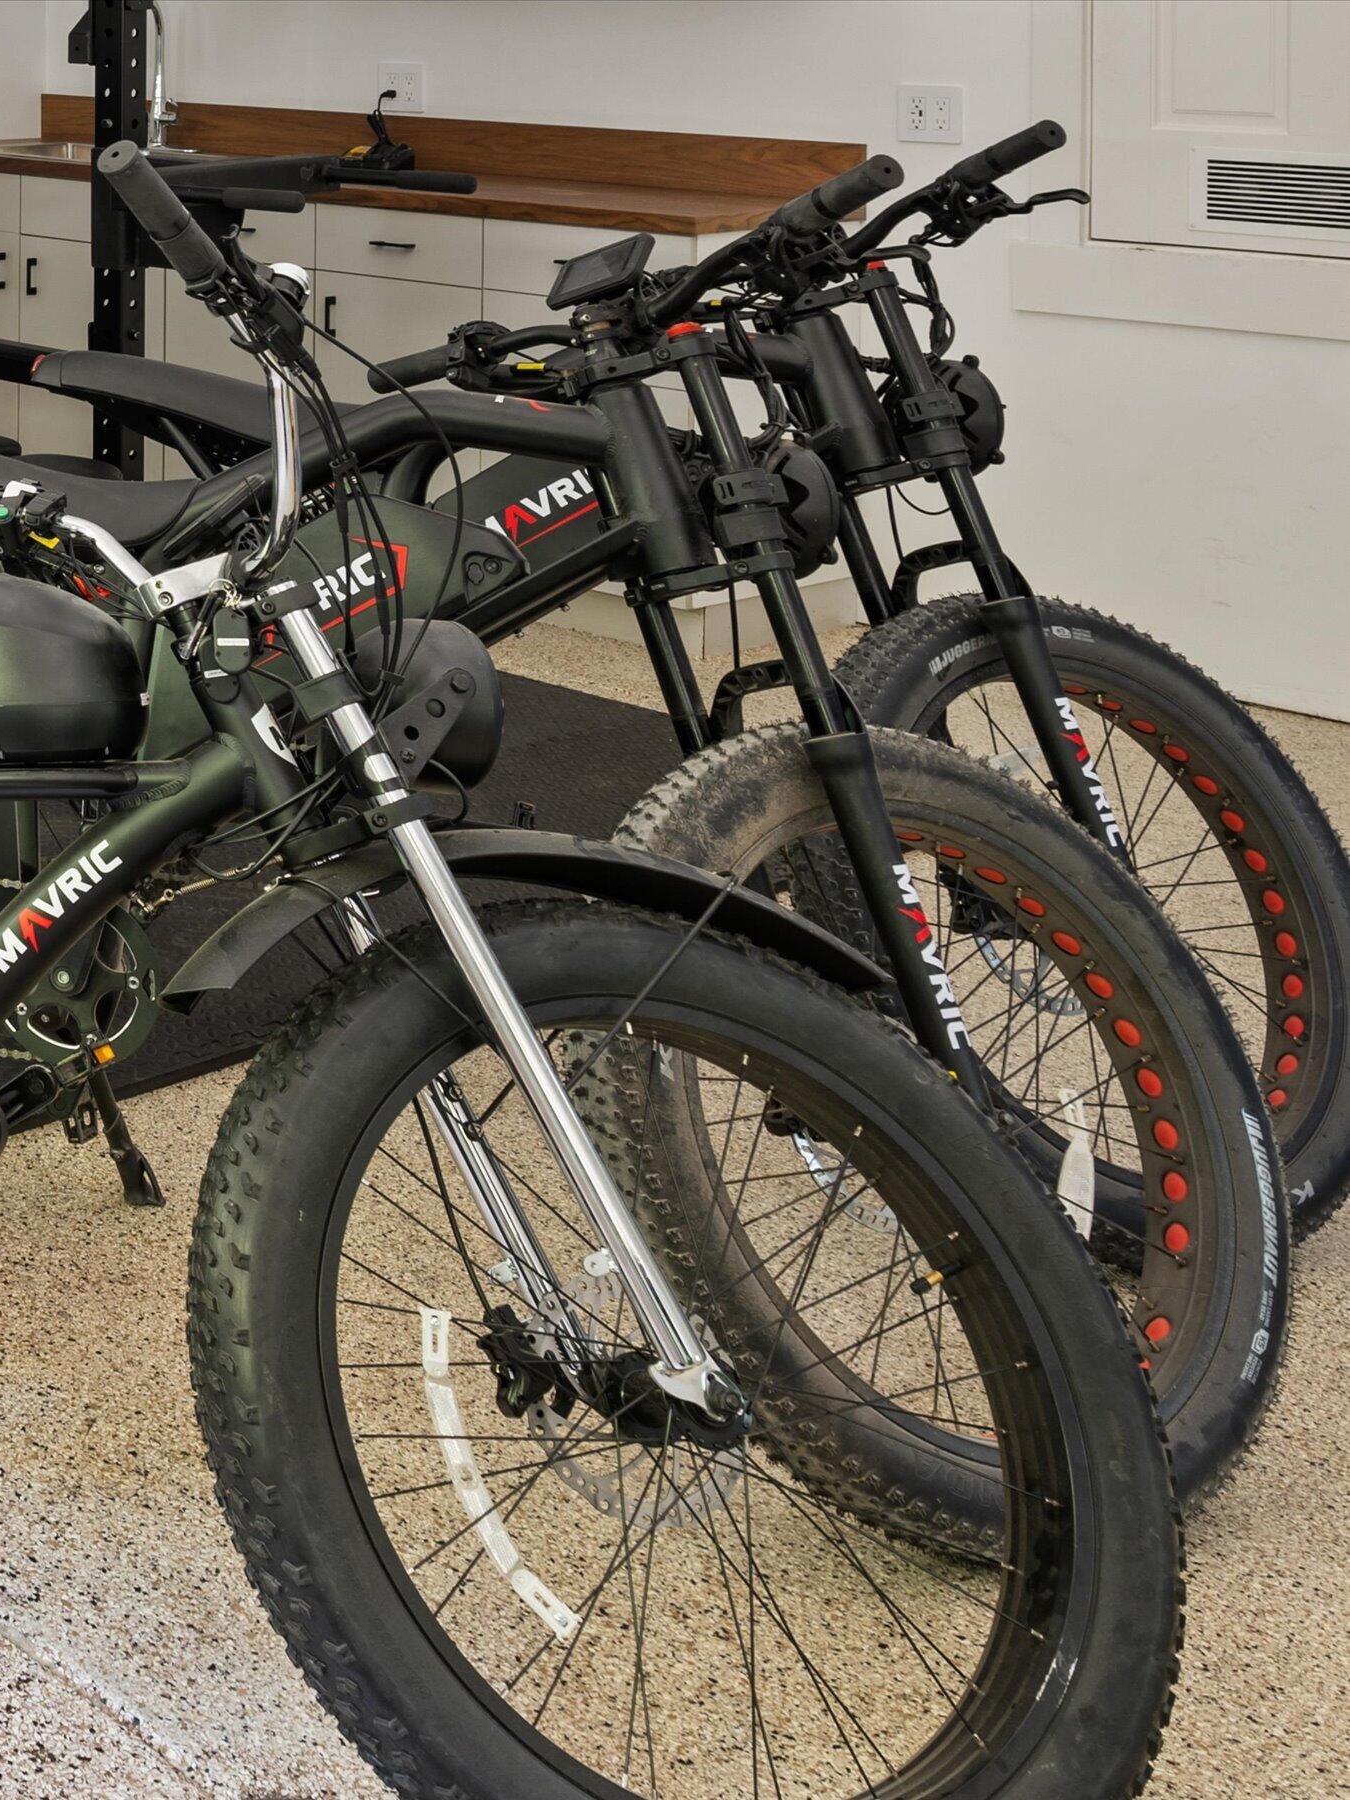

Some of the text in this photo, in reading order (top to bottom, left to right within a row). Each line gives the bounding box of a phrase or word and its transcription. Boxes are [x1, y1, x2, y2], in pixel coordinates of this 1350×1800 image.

[485, 468, 594, 542] AVRI
[312, 551, 387, 611] RIC
[1054, 697, 1120, 847] MAVRIC
[892, 864, 972, 1050] MAVRIC
[1250, 1142, 1279, 1287] JUGGERNAUT
